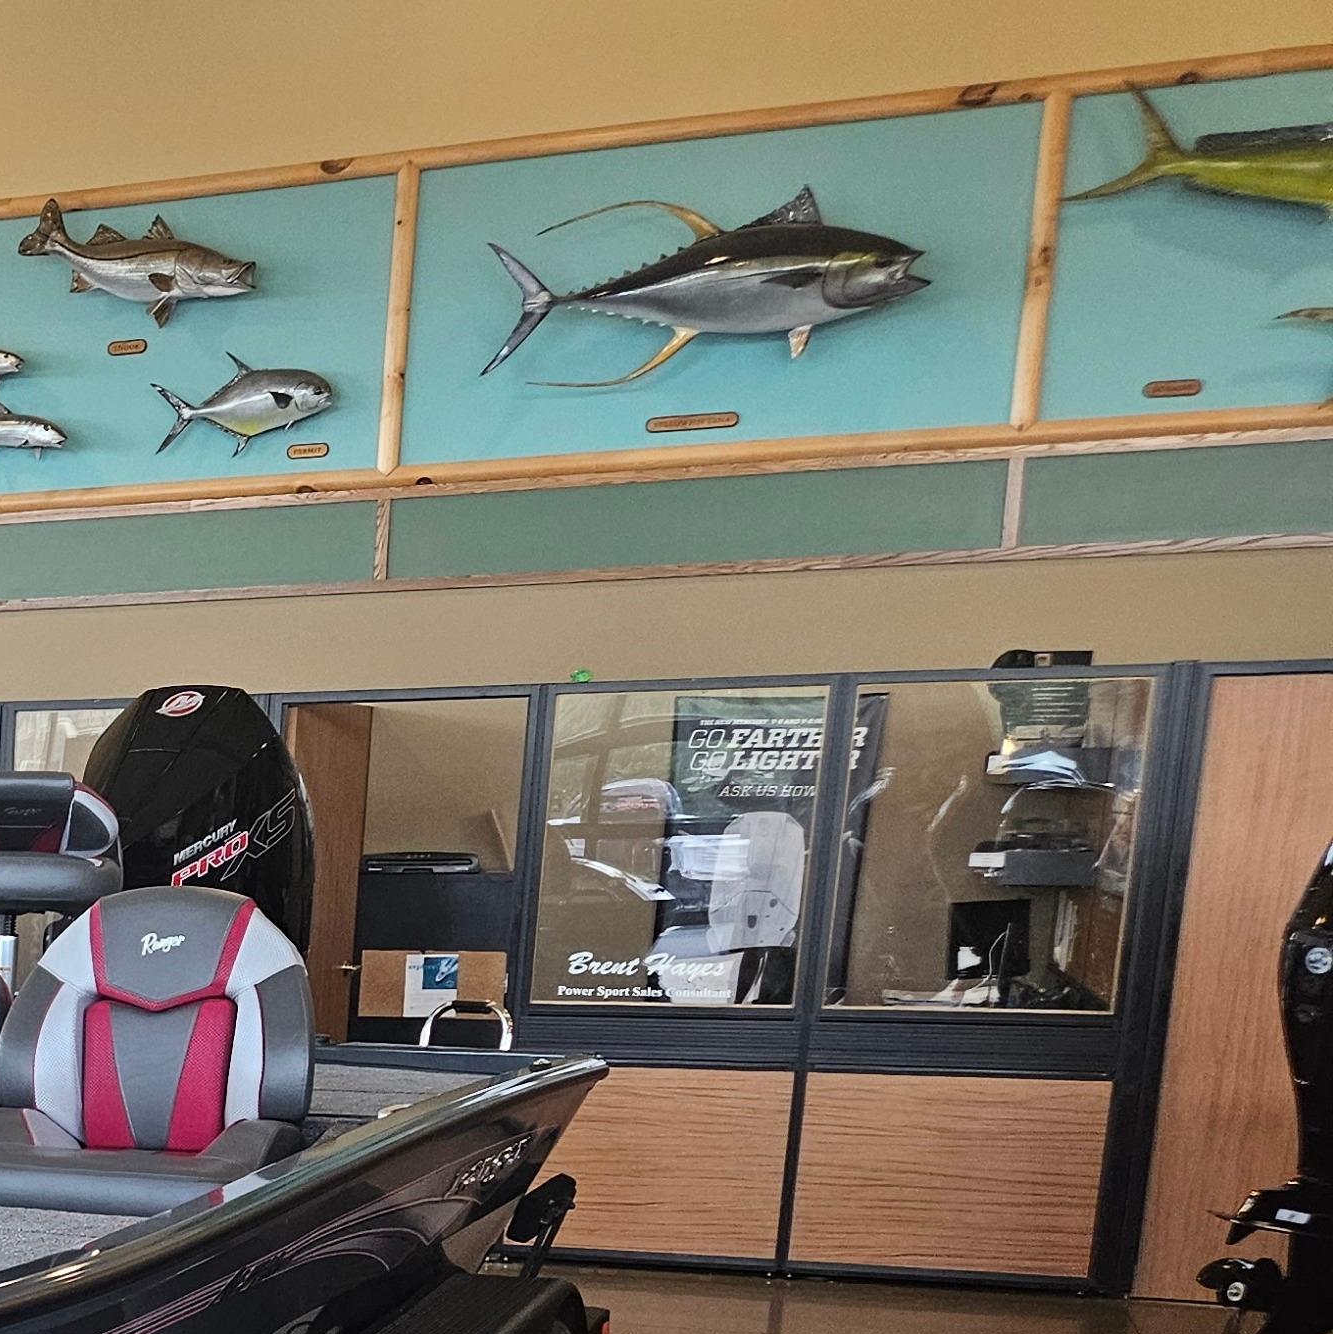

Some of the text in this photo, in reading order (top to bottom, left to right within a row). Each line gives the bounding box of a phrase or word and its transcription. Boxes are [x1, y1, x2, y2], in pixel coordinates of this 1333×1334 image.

[688, 726, 869, 750] GO FARTHR
[728, 750, 861, 771] LIGHTR
[718, 785, 754, 798] ASK
[755, 785, 777, 797] US
[173, 818, 238, 867] MERCURY
[171, 830, 249, 887] PRO
[140, 932, 186, 956] Ranger
[568, 951, 726, 983] Brent Hayes
[557, 985, 595, 997] Power
[596, 986, 630, 999] Sport
[632, 986, 663, 997] Sales
